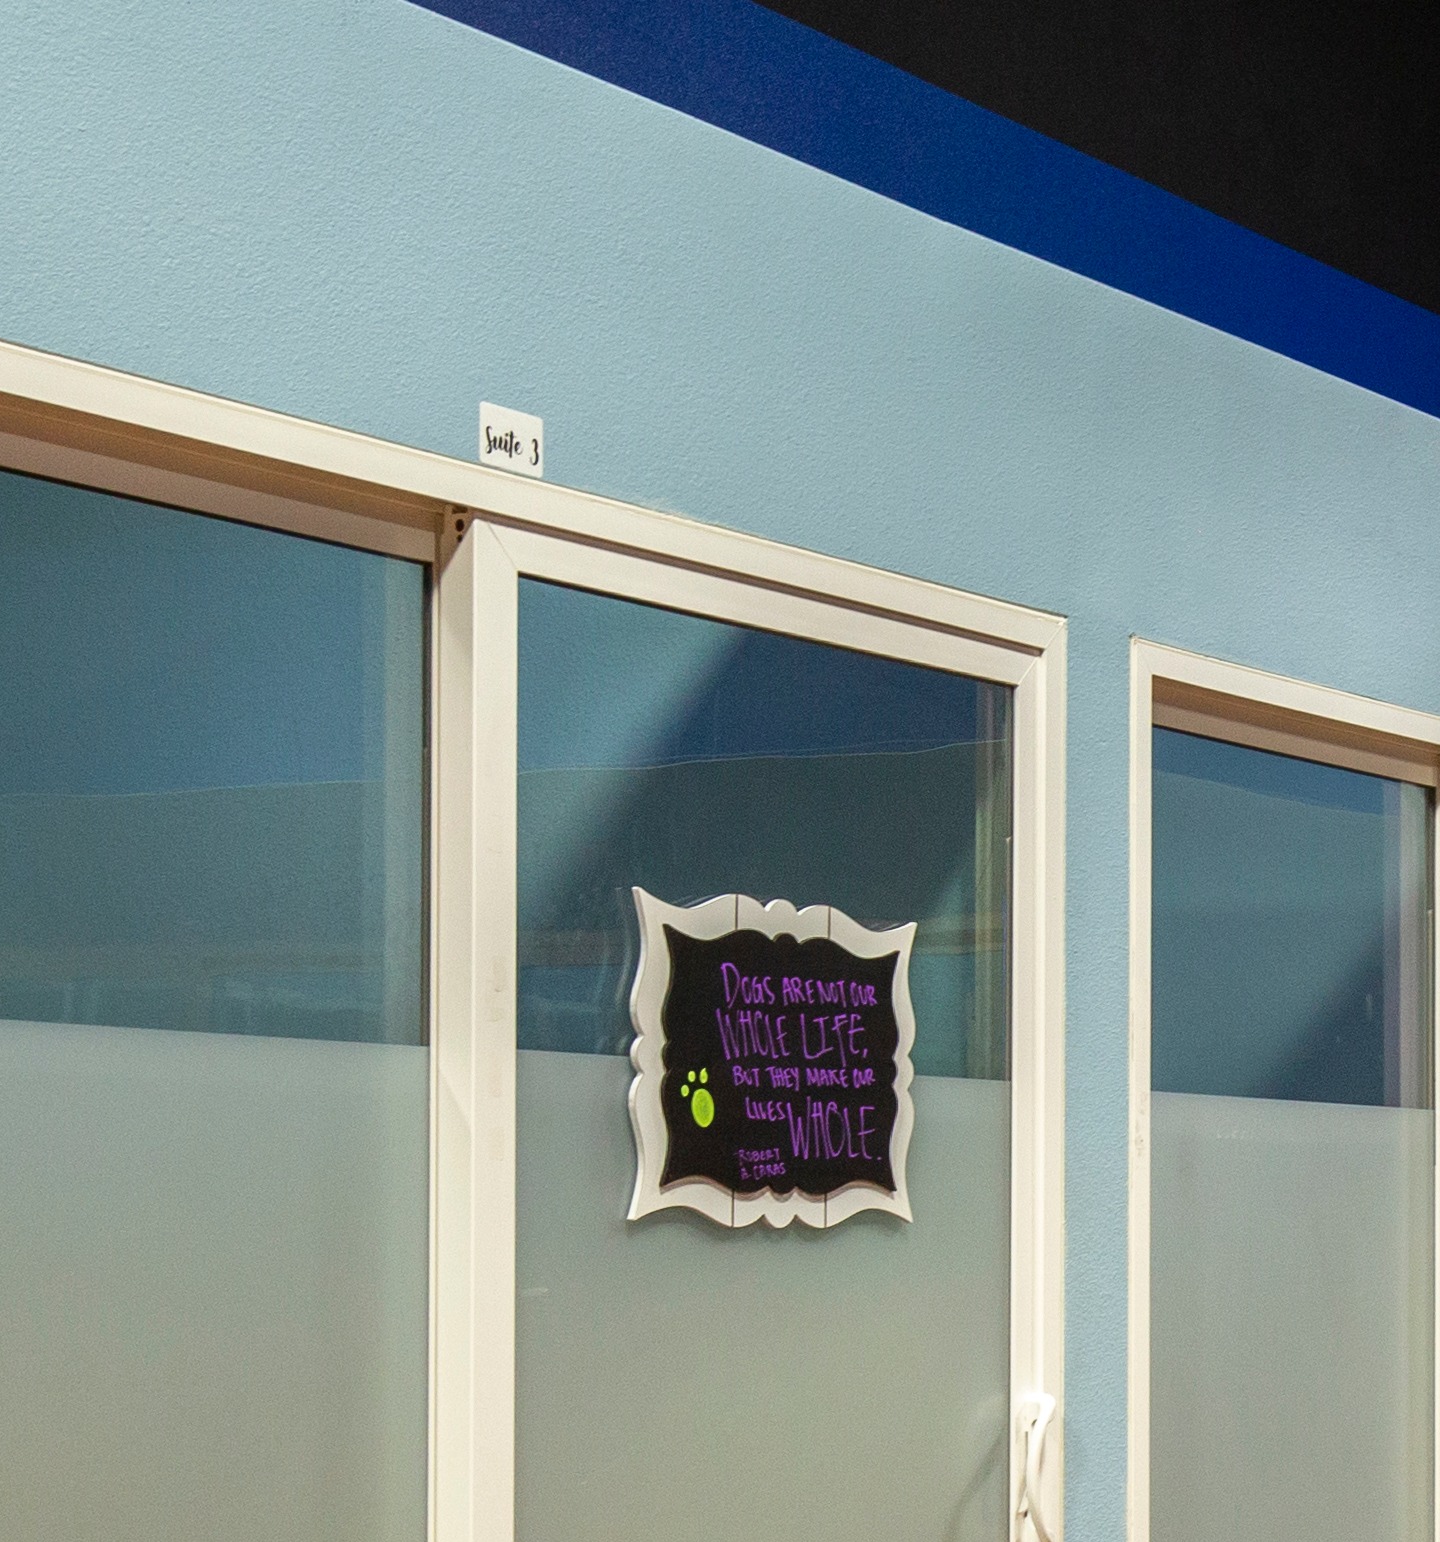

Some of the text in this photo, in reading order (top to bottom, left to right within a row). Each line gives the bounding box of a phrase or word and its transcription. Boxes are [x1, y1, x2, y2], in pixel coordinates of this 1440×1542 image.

[486, 426, 539, 466] Suite 3
[720, 962, 878, 1009] DOGS ARE NOT OUR
[716, 1008, 791, 1060] WHOLE
[732, 1065, 876, 1091] BUT THEY MAKE OUR
[745, 1096, 786, 1121] LIVES
